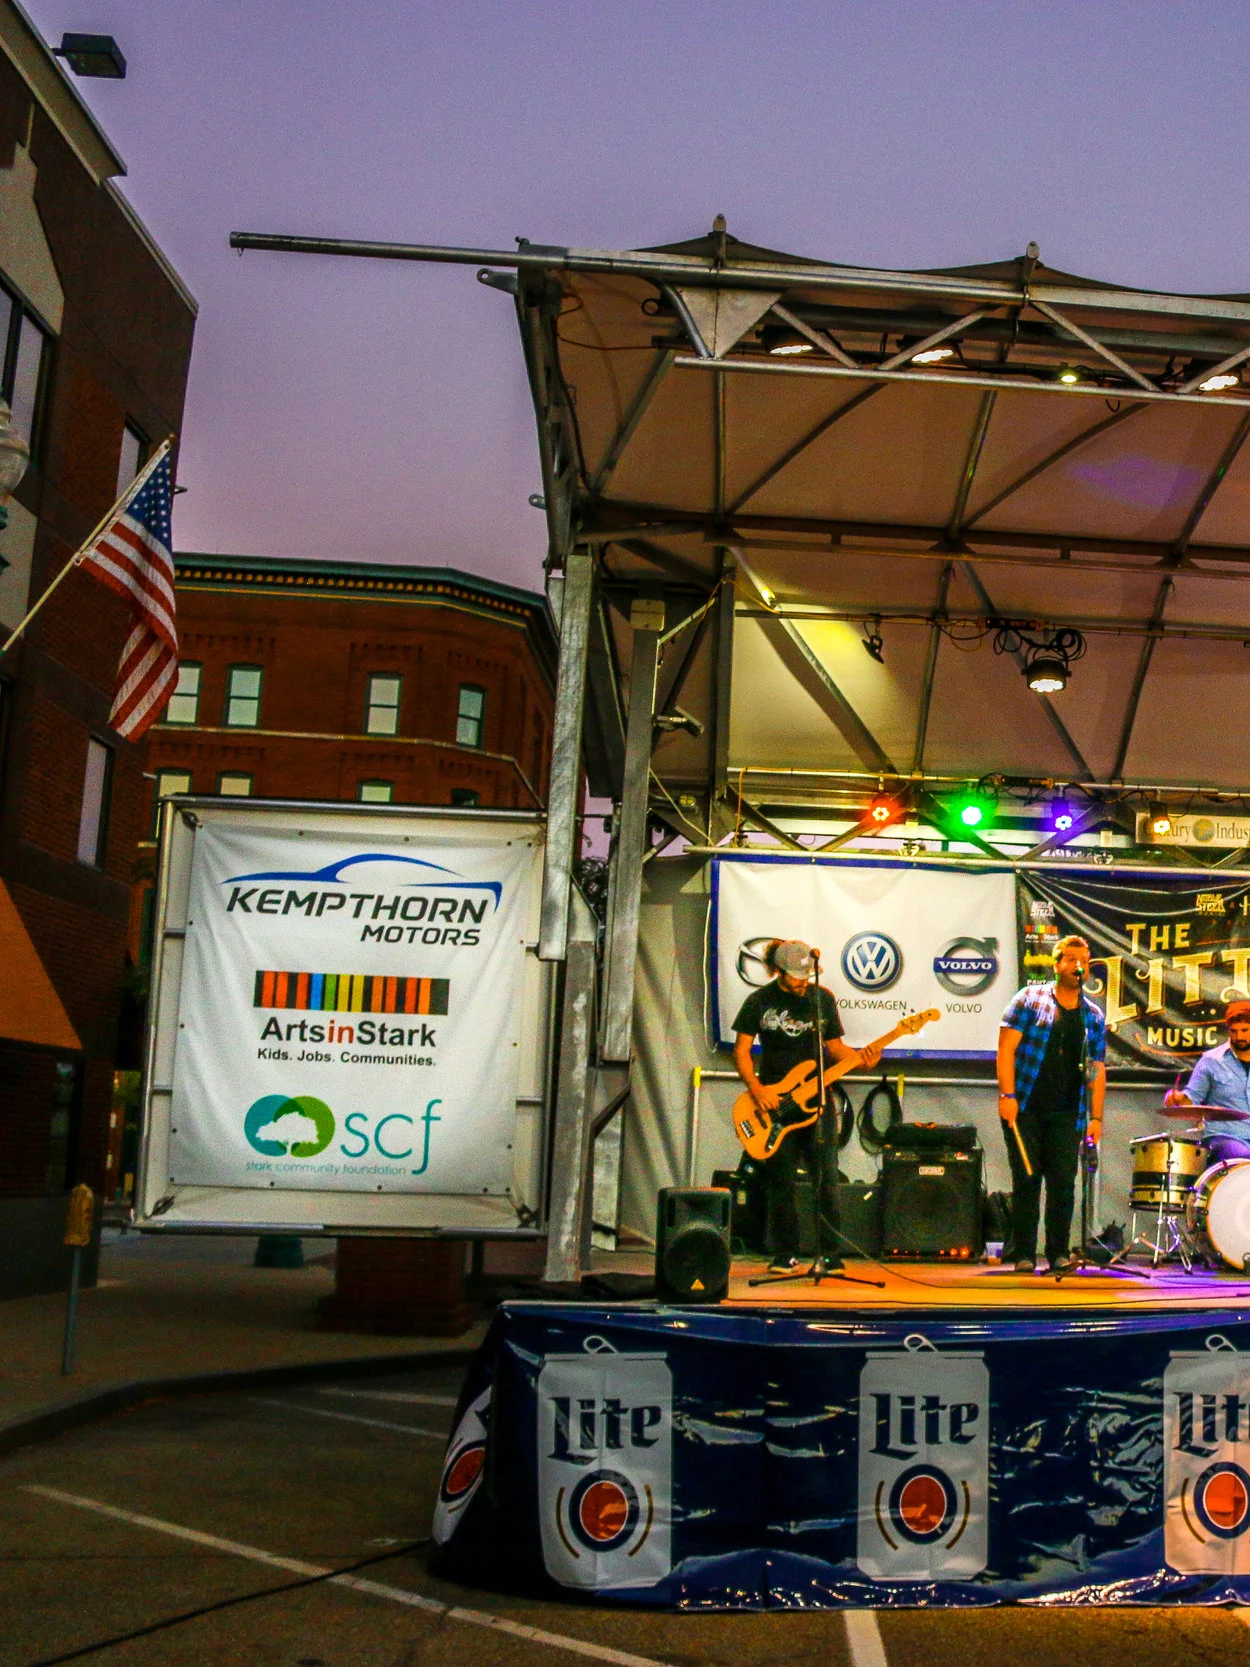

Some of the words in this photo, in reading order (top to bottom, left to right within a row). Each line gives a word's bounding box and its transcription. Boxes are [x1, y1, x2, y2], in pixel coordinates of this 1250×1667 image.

[226, 887, 488, 924] KEMPTHORN
[360, 924, 480, 946] MOTORS
[1125, 923, 1191, 955] THE
[938, 960, 993, 970] VOLVO
[946, 1003, 982, 1013] VOLVO
[1147, 1026, 1218, 1047] MUSIC
[257, 1048, 292, 1061] Kids.
[297, 1050, 335, 1063] Jobs.
[340, 1052, 437, 1067] Communities.
[340, 1099, 442, 1175] scf
[246, 1161, 273, 1171] stark
[275, 1162, 339, 1176] community
[343, 1164, 406, 1175] foundation
[547, 1396, 662, 1466] Lite
[868, 1392, 979, 1461] Lite
